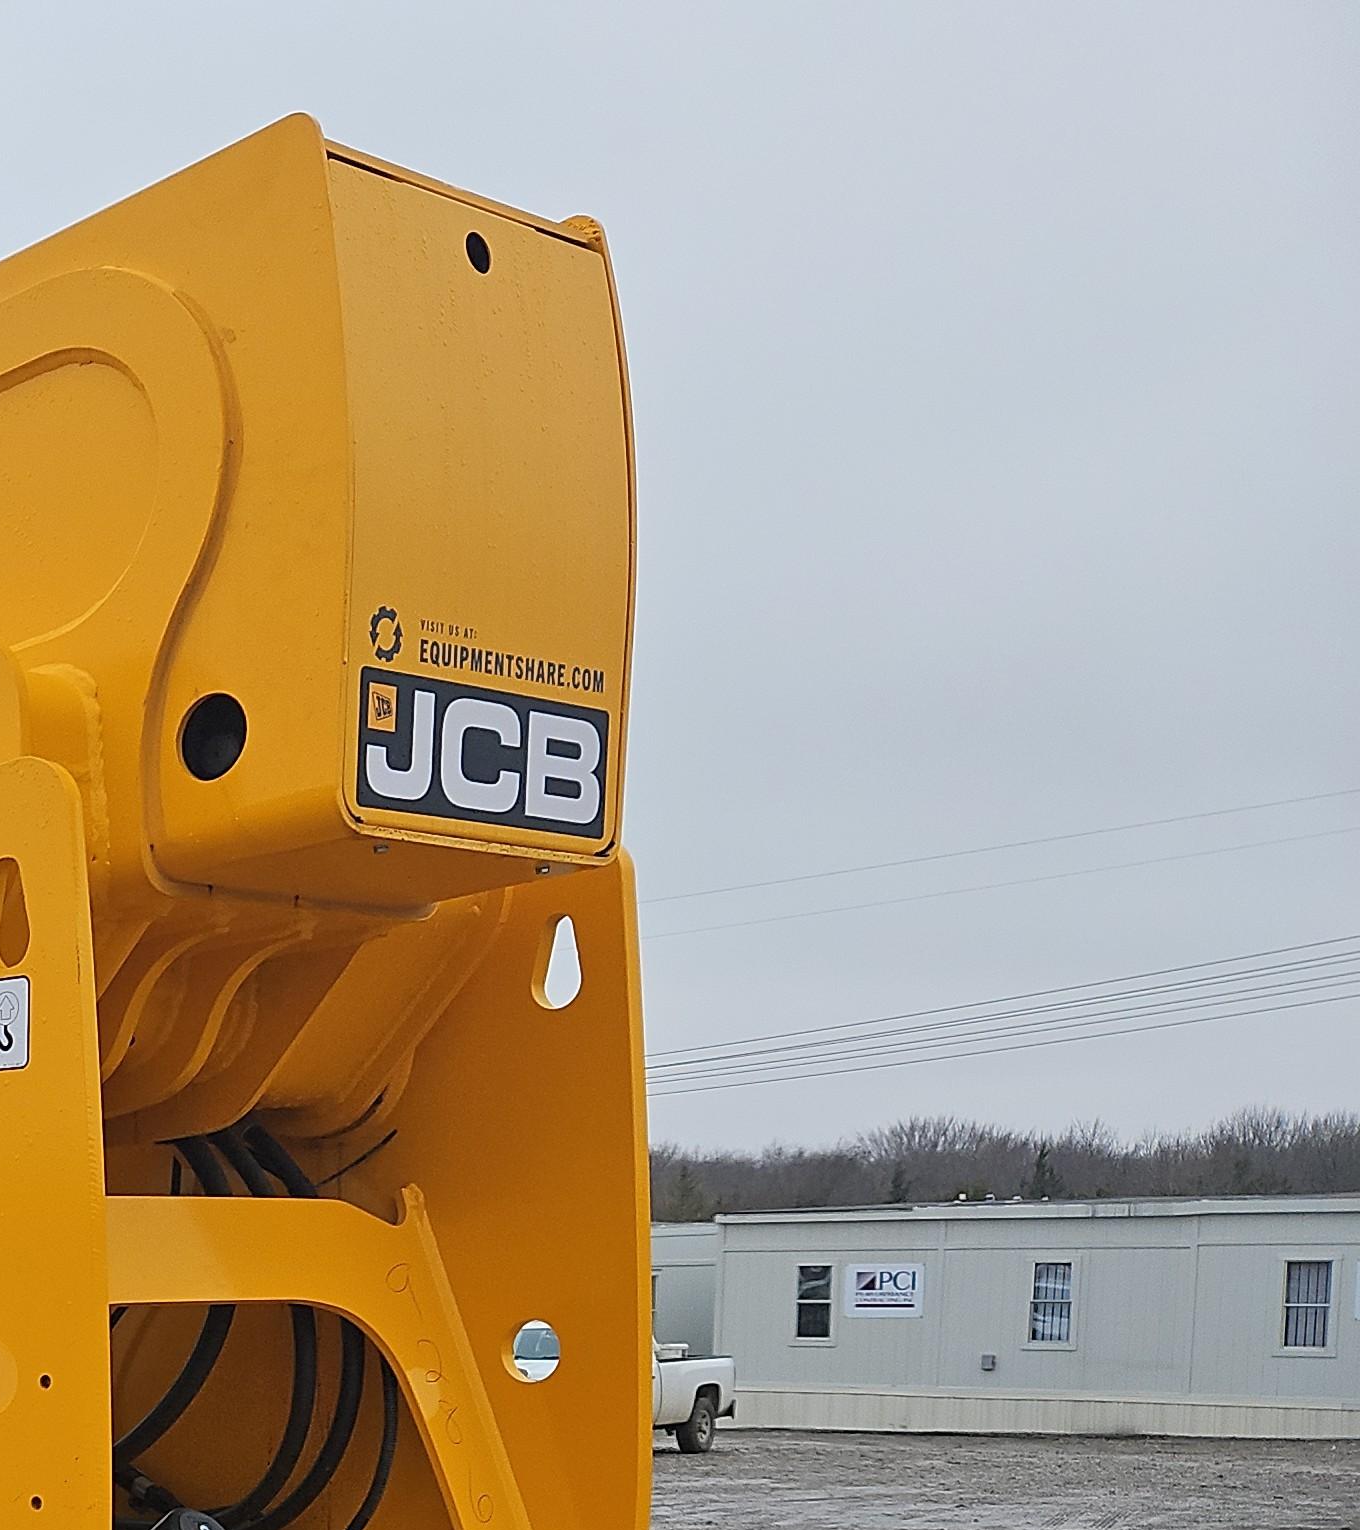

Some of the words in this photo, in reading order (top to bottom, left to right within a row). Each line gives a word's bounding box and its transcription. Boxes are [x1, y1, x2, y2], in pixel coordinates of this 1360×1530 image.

[420, 619, 444, 635] VISIT
[449, 626, 460, 638] US
[464, 628, 478, 640] AT:
[419, 638, 605, 694] EQUIPMENTSHARE.COM
[366, 690, 601, 825] JCB
[880, 1270, 917, 1291] PCI
